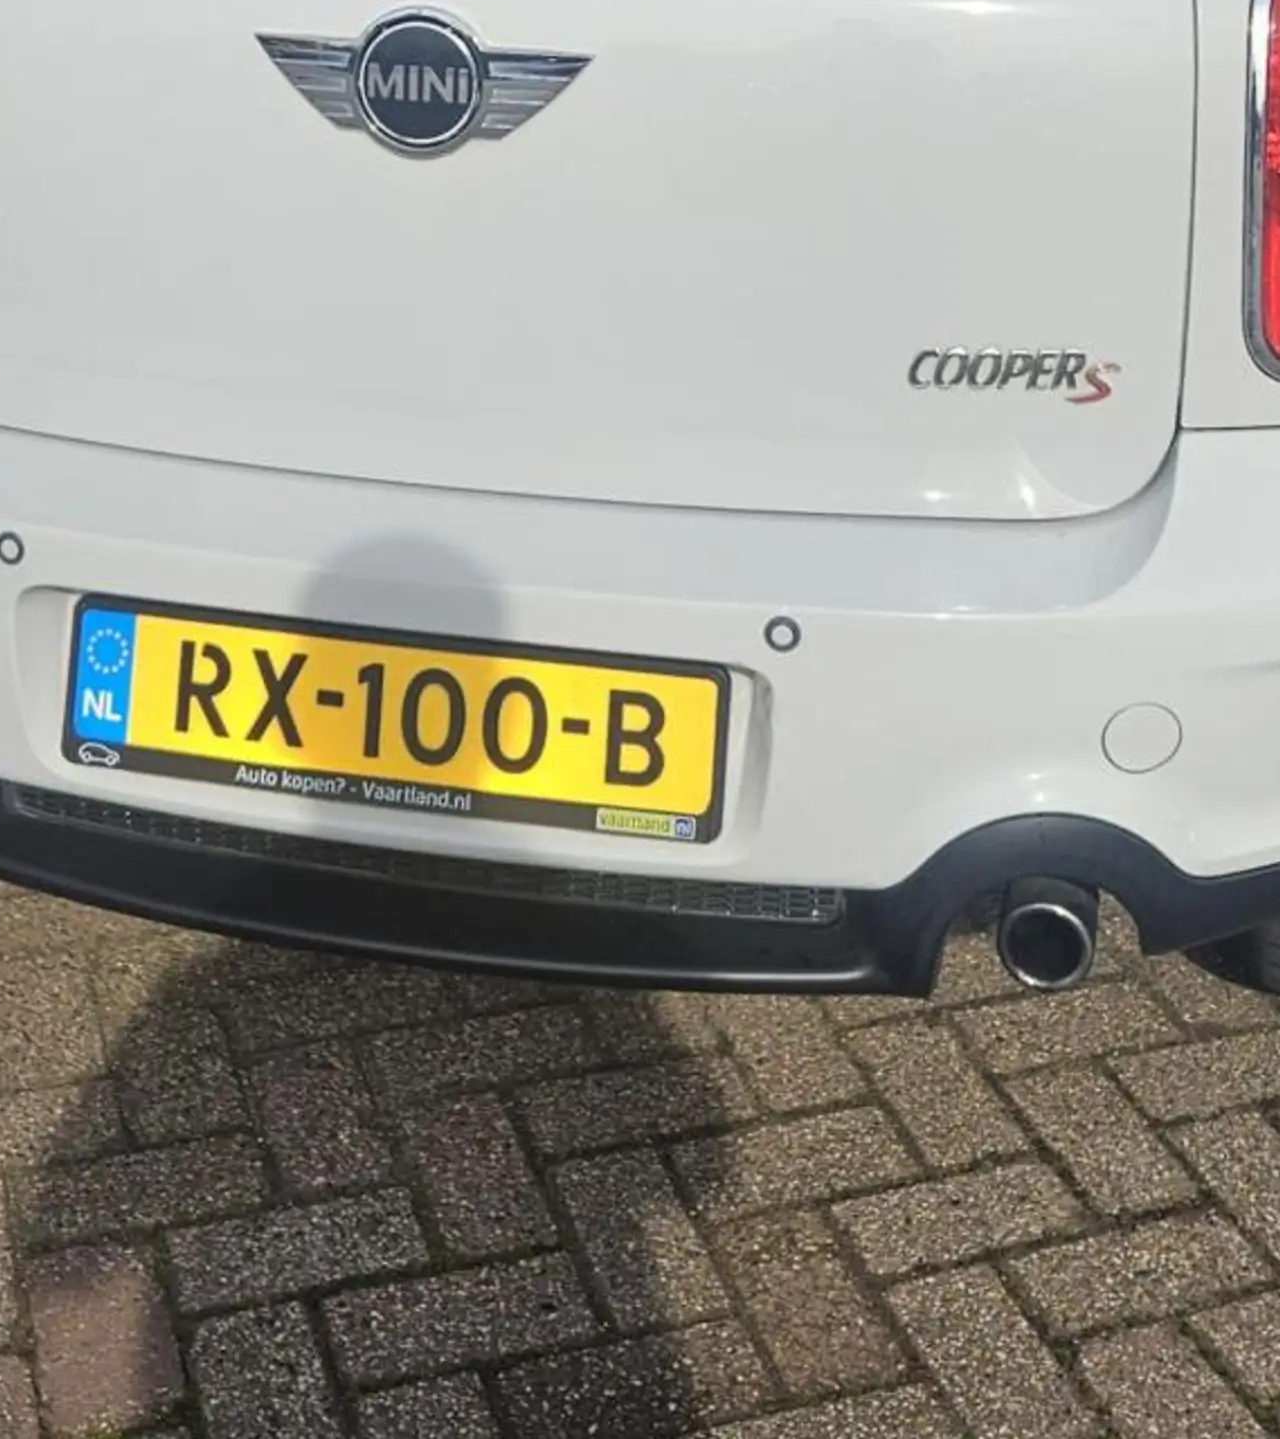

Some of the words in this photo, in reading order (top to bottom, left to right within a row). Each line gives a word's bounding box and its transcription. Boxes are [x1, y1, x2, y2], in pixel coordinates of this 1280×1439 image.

[369, 62, 470, 105] MINI
[907, 350, 1086, 391] COOPER
[81, 687, 122, 724] NL
[175, 639, 667, 788] RX-100-B
[235, 765, 277, 787] Auto
[281, 770, 347, 796] kopen?
[362, 781, 471, 811] Vaartland.nl
